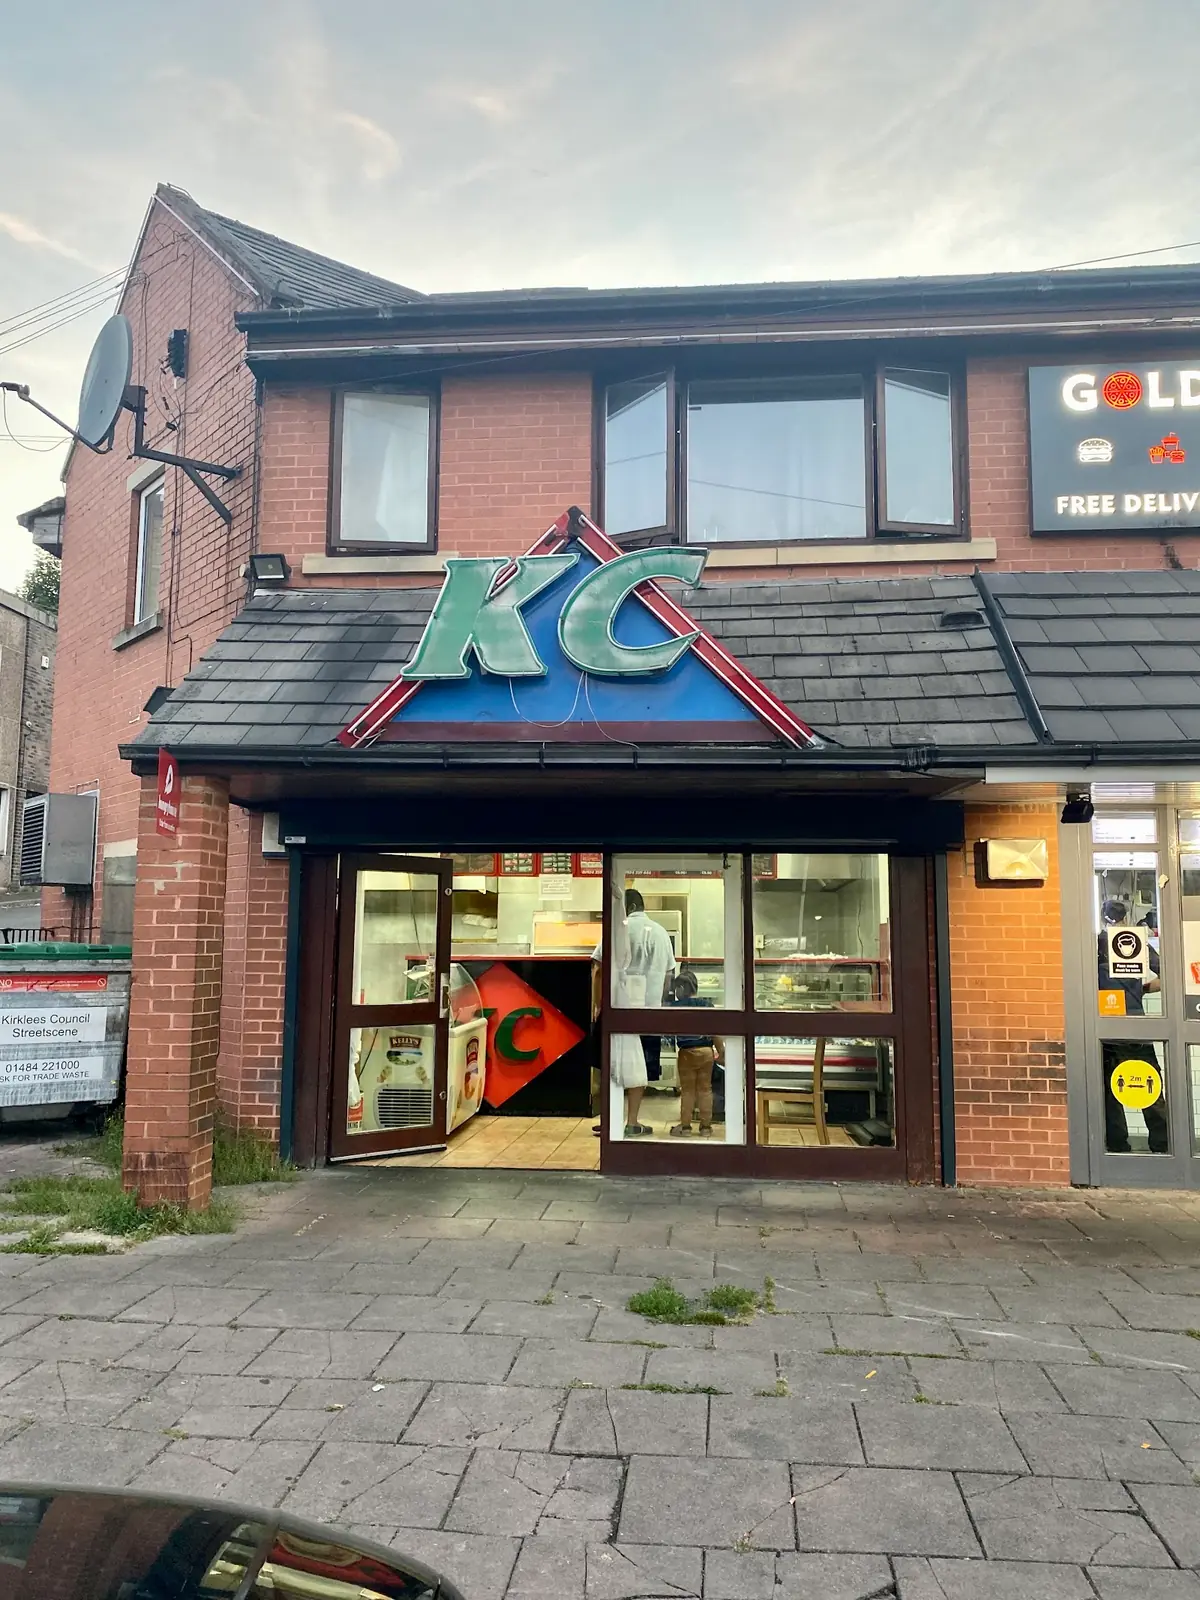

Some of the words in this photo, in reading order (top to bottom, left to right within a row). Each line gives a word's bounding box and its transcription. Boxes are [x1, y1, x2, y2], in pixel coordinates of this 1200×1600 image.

[1056, 495, 1115, 514] FREE
[1124, 492, 1200, 513] DELIV
[401, 546, 710, 681] KC
[1, 1015, 46, 1025] Kirklees
[50, 1014, 90, 1024] Council
[12, 1028, 78, 1038] Streetscene
[5, 1062, 38, 1073] 01484
[42, 1060, 80, 1071] 221000
[12, 1074, 31, 1082] FOR
[33, 1072, 60, 1081] TRADE
[62, 1071, 90, 1079] WASTE
